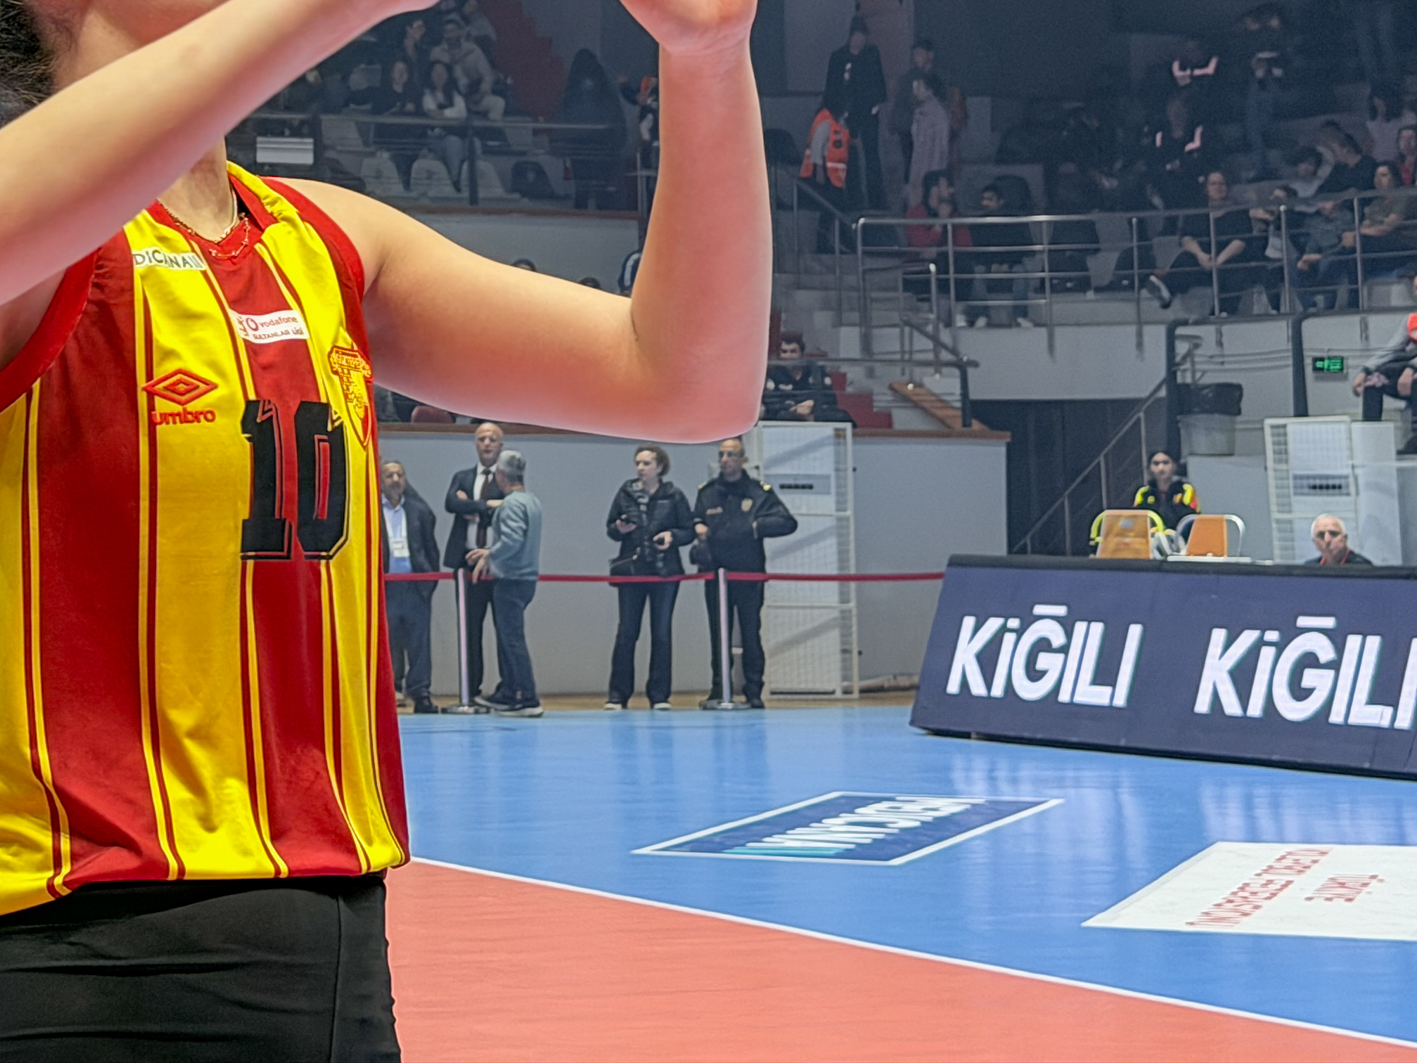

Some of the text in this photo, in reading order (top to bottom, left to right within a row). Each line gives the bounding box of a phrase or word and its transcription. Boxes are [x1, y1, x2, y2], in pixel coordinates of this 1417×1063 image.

[259, 317, 299, 328] vodafone
[151, 407, 216, 425] umbro
[240, 400, 349, 560] 10
